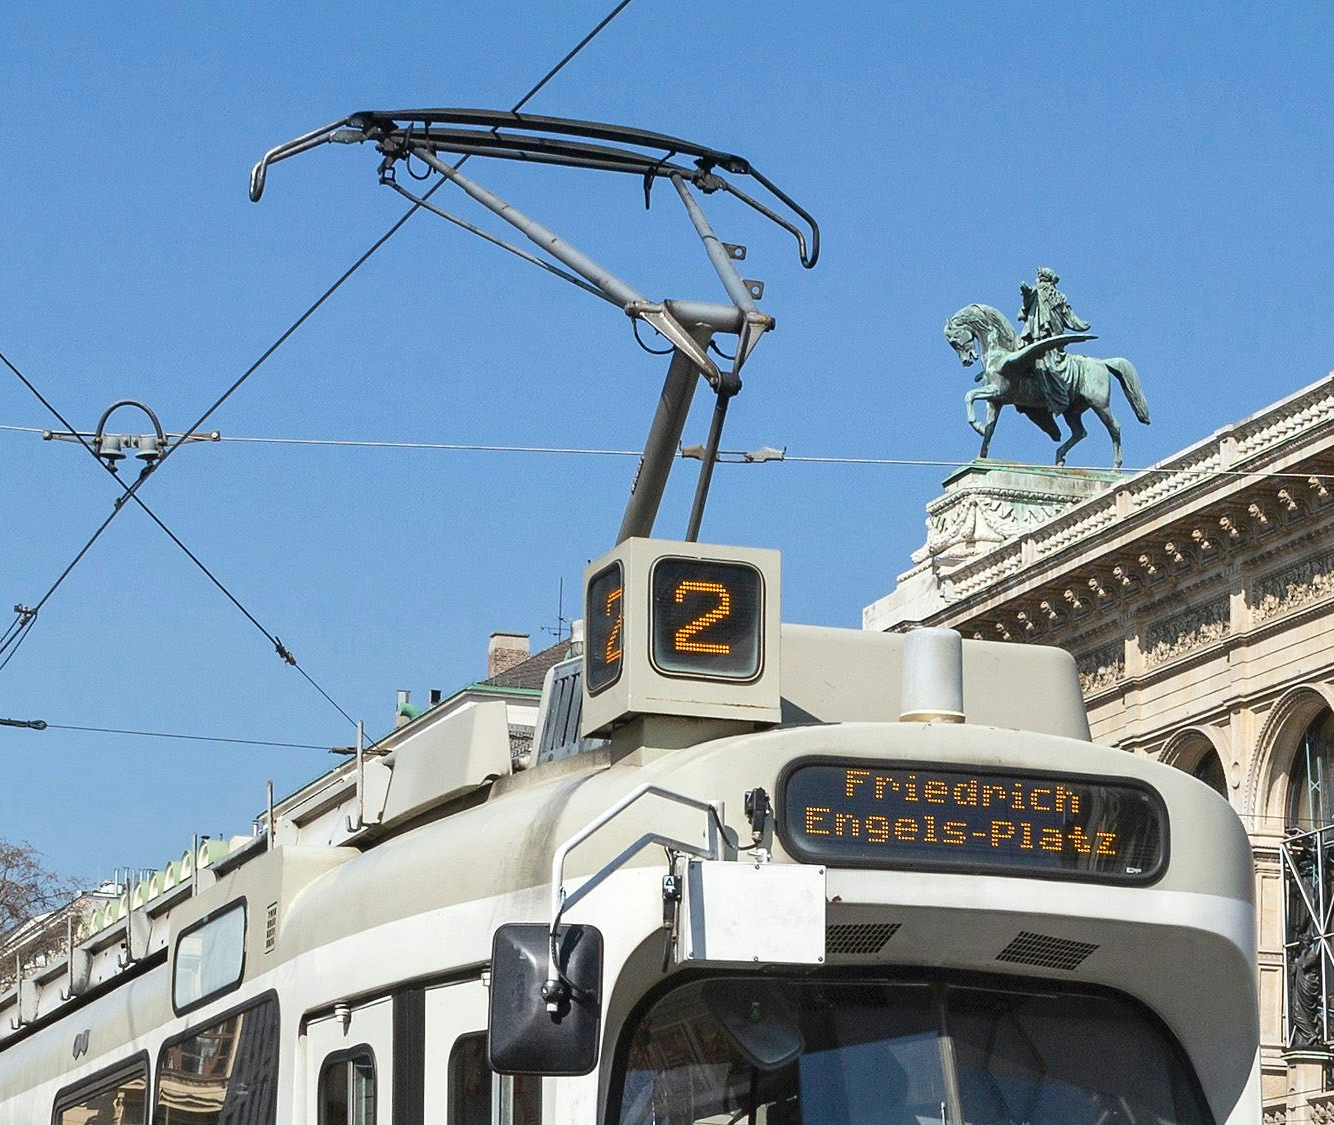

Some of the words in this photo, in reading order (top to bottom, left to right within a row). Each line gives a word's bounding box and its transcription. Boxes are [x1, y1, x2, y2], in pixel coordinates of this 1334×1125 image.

[675, 580, 730, 655] 2
[845, 769, 1081, 814] Friedrich
[805, 805, 1117, 856] Engels-Platz
